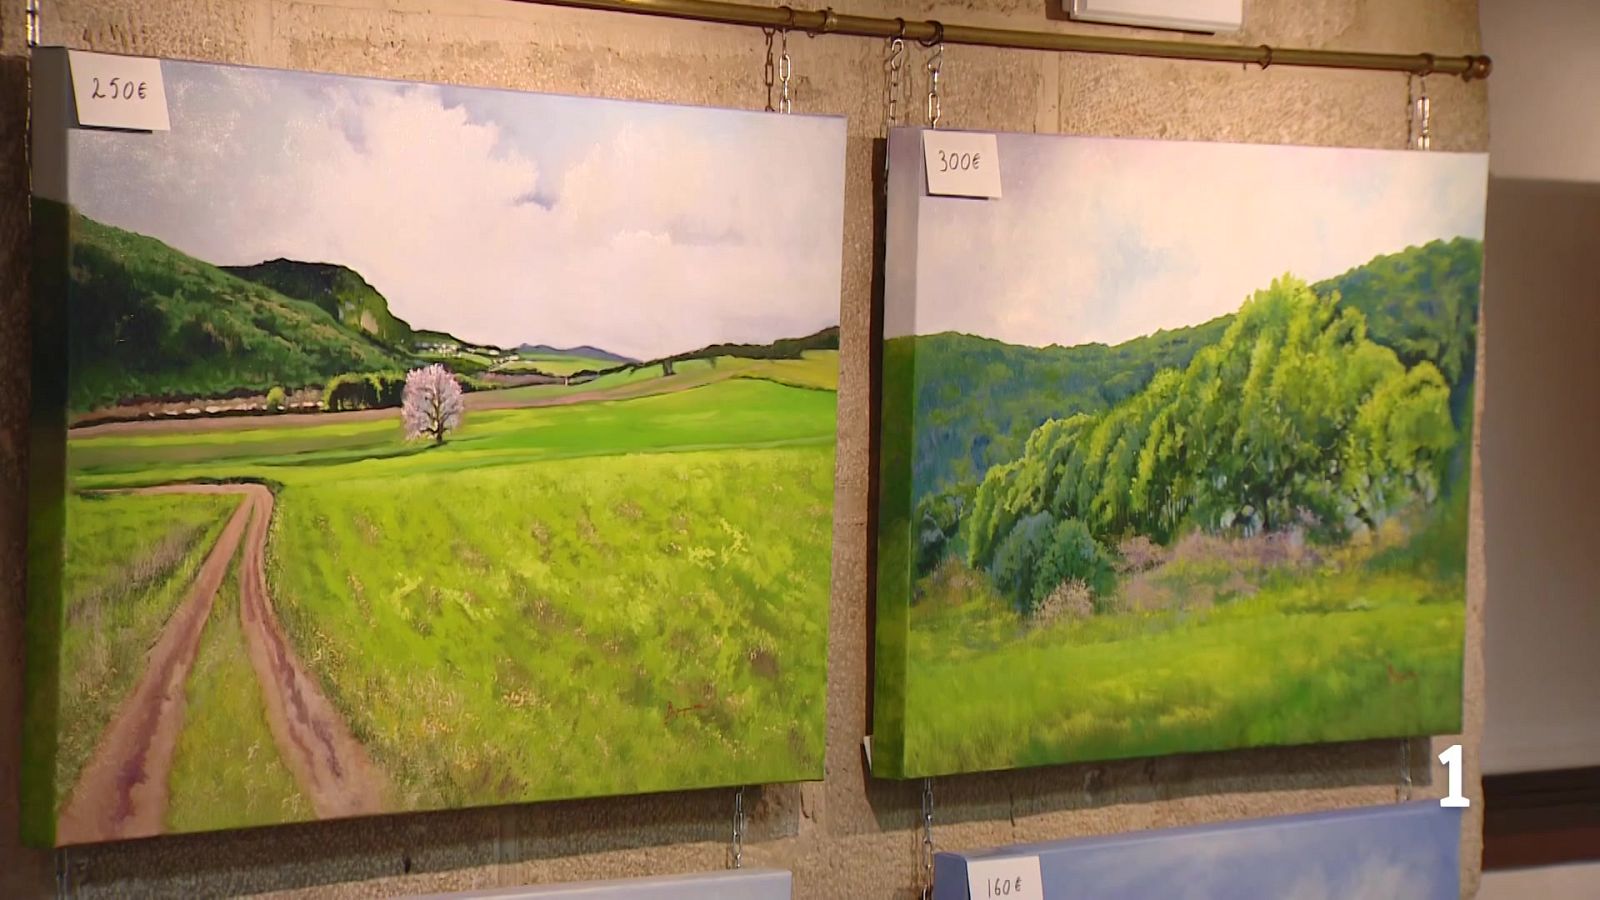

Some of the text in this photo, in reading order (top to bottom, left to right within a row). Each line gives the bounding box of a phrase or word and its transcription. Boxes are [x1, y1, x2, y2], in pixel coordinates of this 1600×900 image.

[91, 77, 147, 100] 250€
[938, 149, 981, 172] 300€
[987, 876, 1022, 898] 160€
